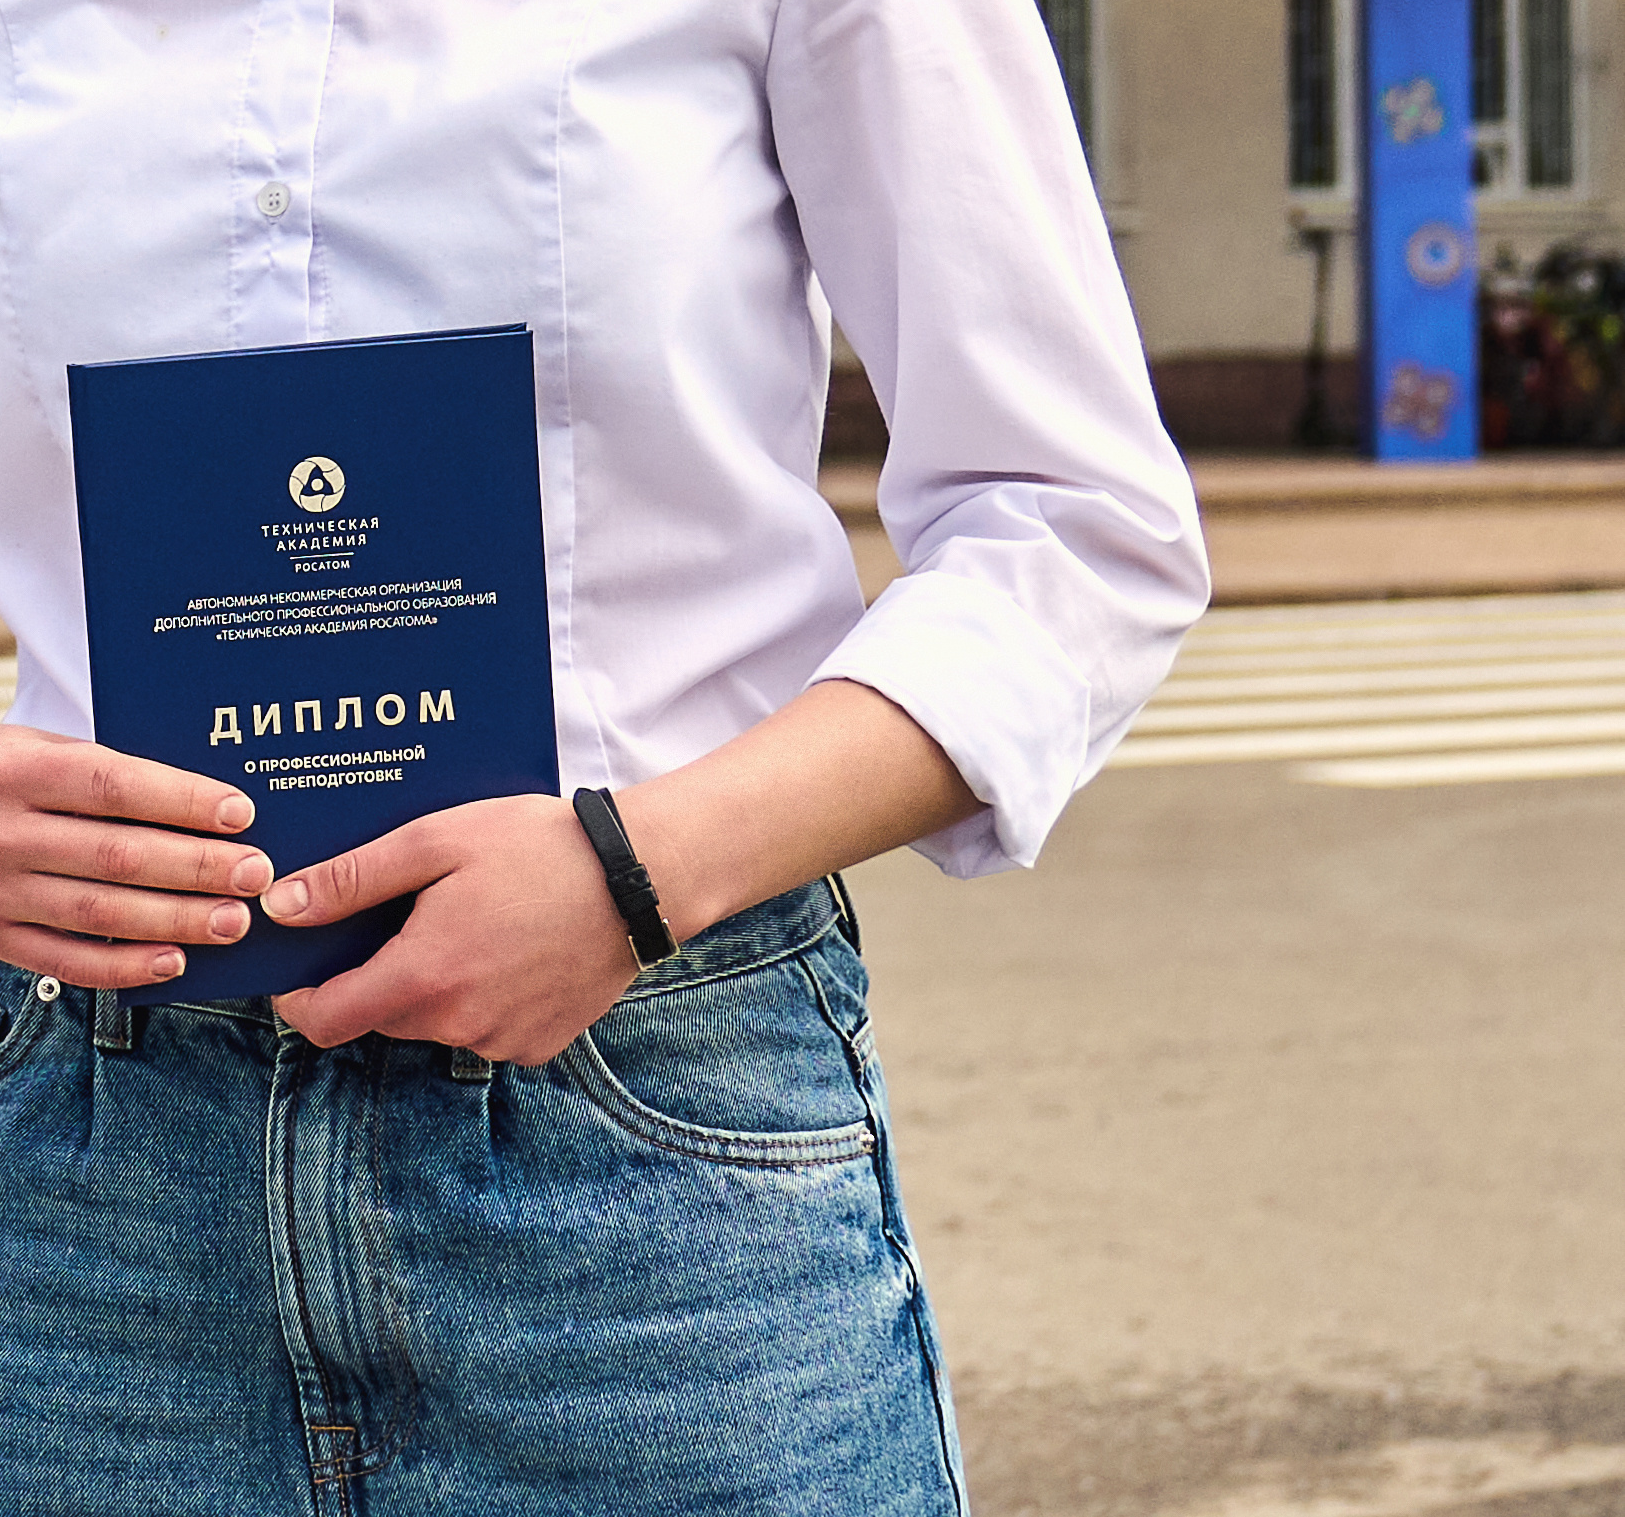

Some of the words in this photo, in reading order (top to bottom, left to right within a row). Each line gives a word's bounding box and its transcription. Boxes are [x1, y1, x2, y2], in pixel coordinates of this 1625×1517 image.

[261, 516, 379, 538] ТЕХНИЧЕСКАЯ
[276, 533, 367, 552] АКАДЕМИЯ
[295, 559, 351, 573] РОСАТОМ
[187, 594, 267, 611] АВТОНОМНАЯ
[270, 585, 377, 604] НЕКОММЕРЧЕСКАЯ
[379, 578, 462, 596] ОРГАНИЗАЦИЯ
[153, 610, 274, 633] ДОПОЛНИТЕЛЬНОГО
[276, 599, 411, 620] ПРОФЕССИОНАЛЬНОГО
[413, 591, 497, 610] ОБРАЗОВАНИЯ
[216, 624, 302, 641] «ТЕХНИЧЕСКАЯ
[304, 619, 368, 635] АКАДЕМИЯ
[370, 614, 438, 629] РОСАТОМА»
[209, 689, 456, 746] ДИПЛОМ
[244, 760, 257, 774] О
[259, 744, 426, 773] ПРОФЕССИОНАЛЬНОЙ
[269, 768, 403, 791] ПЕРЕПОДГОТОВКЕ
